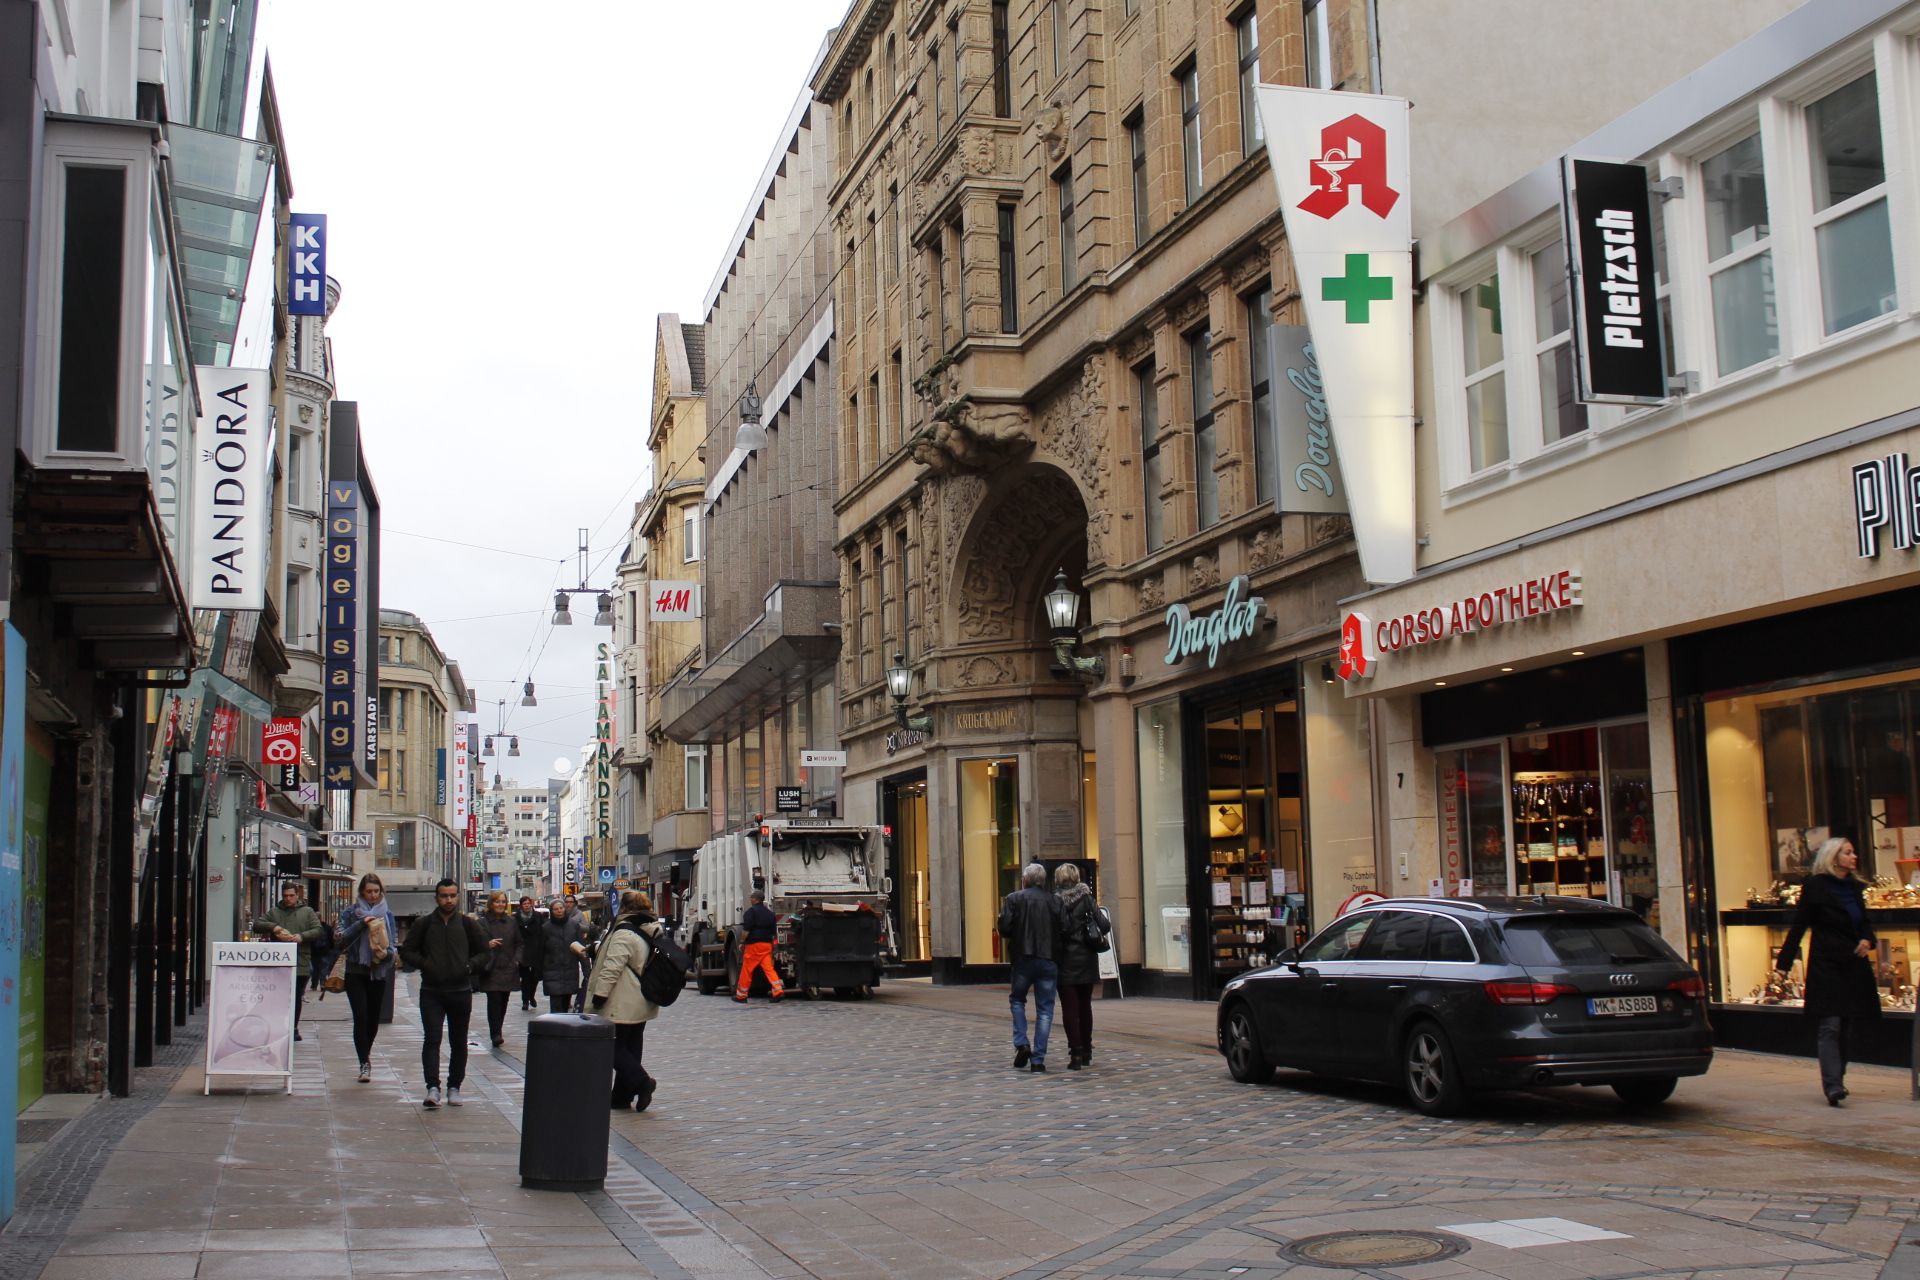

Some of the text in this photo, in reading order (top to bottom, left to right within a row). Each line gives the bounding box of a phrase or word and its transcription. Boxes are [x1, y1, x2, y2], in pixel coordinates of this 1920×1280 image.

[295, 226, 320, 301] KKH
[1596, 209, 1644, 349] pletzsch
[211, 383, 249, 594] PANDORA
[331, 489, 352, 746] vogelsang
[655, 589, 690, 613] H&M
[1164, 575, 1264, 669] Douglas
[1377, 570, 1572, 653] CORSO APOTHEKE
[367, 696, 377, 761] KARSTADT
[597, 642, 610, 838] SALAMANDER
[456, 741, 466, 815] Müller
[330, 833, 371, 847] CHRIST
[565, 848, 576, 881] ÖRTZ
[219, 950, 291, 961] PANDORA
[1594, 1000, 1609, 1014] MK
